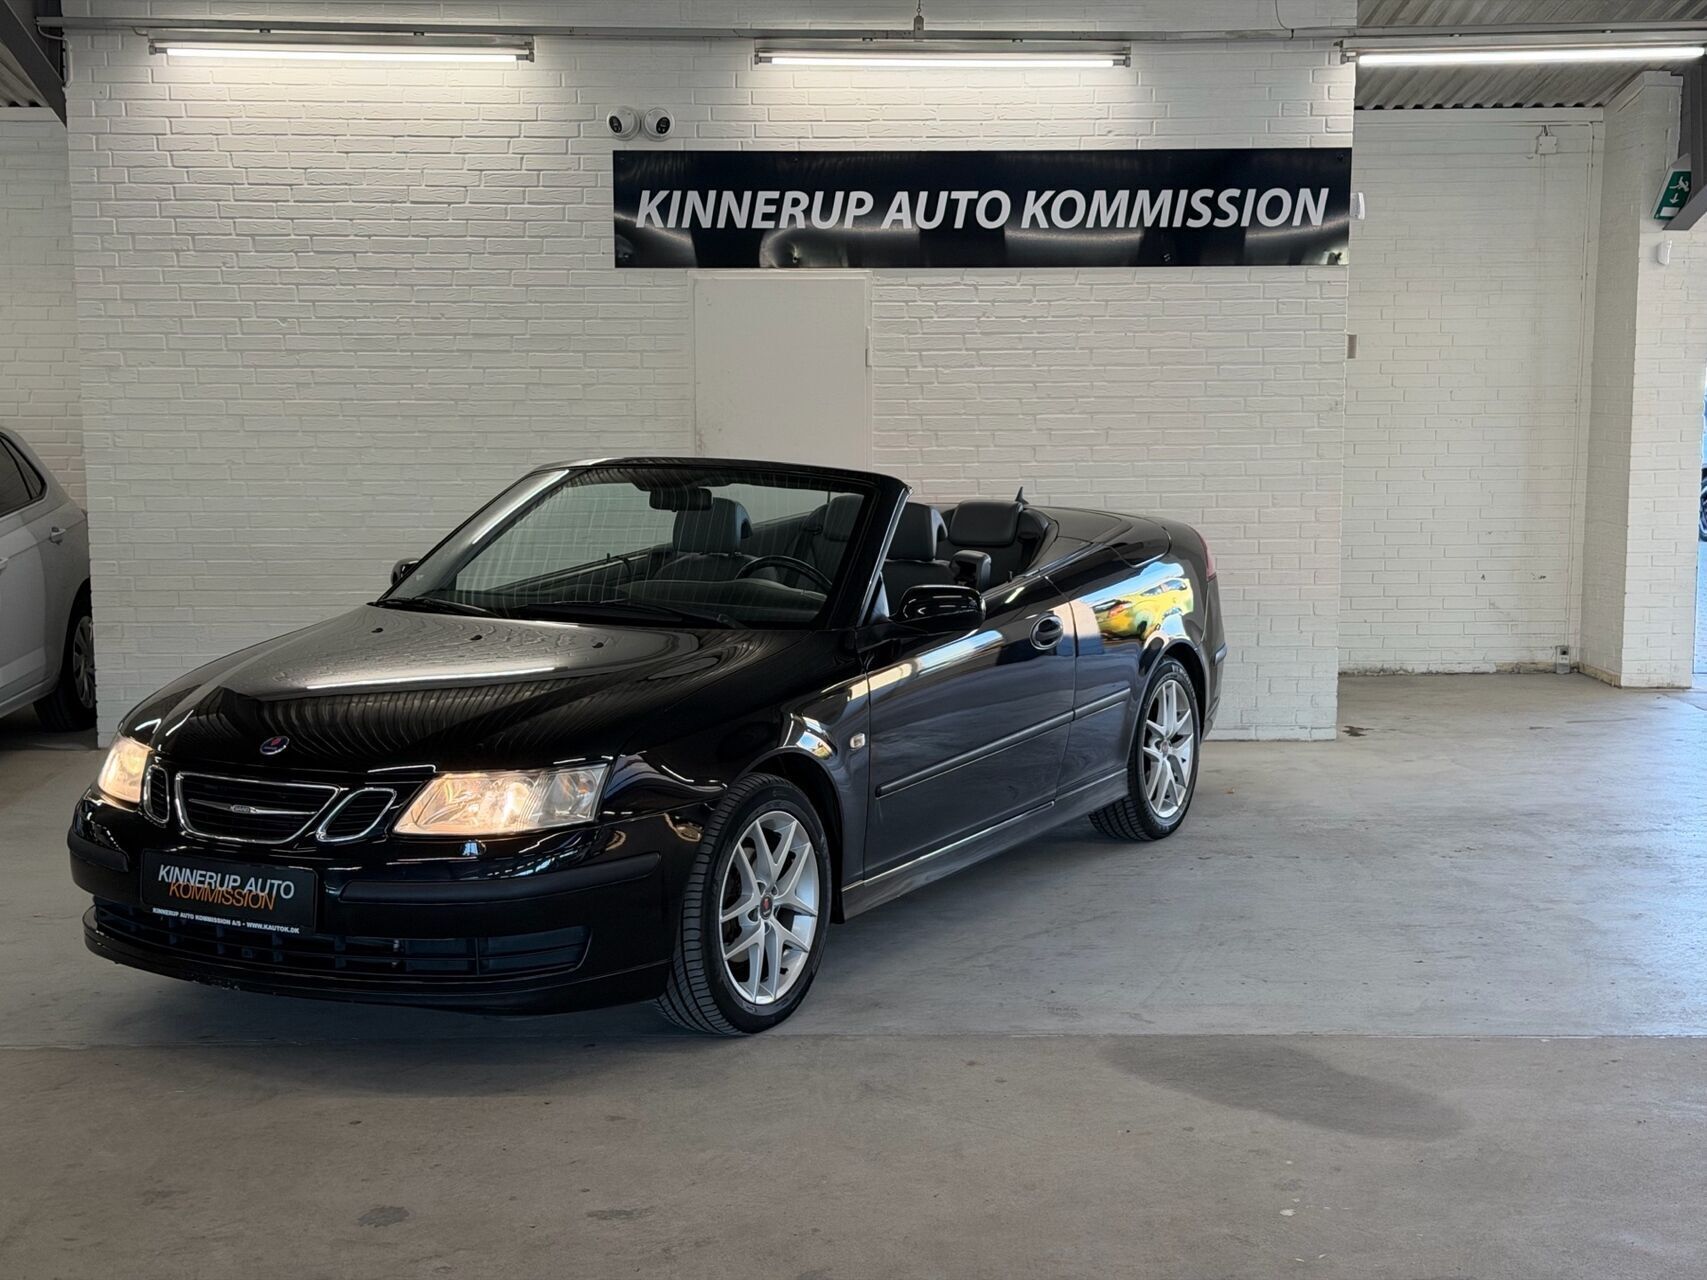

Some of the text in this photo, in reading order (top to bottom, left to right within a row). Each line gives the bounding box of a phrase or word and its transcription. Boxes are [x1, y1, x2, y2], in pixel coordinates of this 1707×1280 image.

[635, 187, 1329, 230] KINNERUP AUTO KOMMISSION
[157, 864, 295, 899] KINNERUP AUTO
[169, 881, 276, 911] KOMMISSION
[152, 907, 300, 934] KINNERUP AUTO KOMMISSION A/S WWW.KAUTOK.DK
